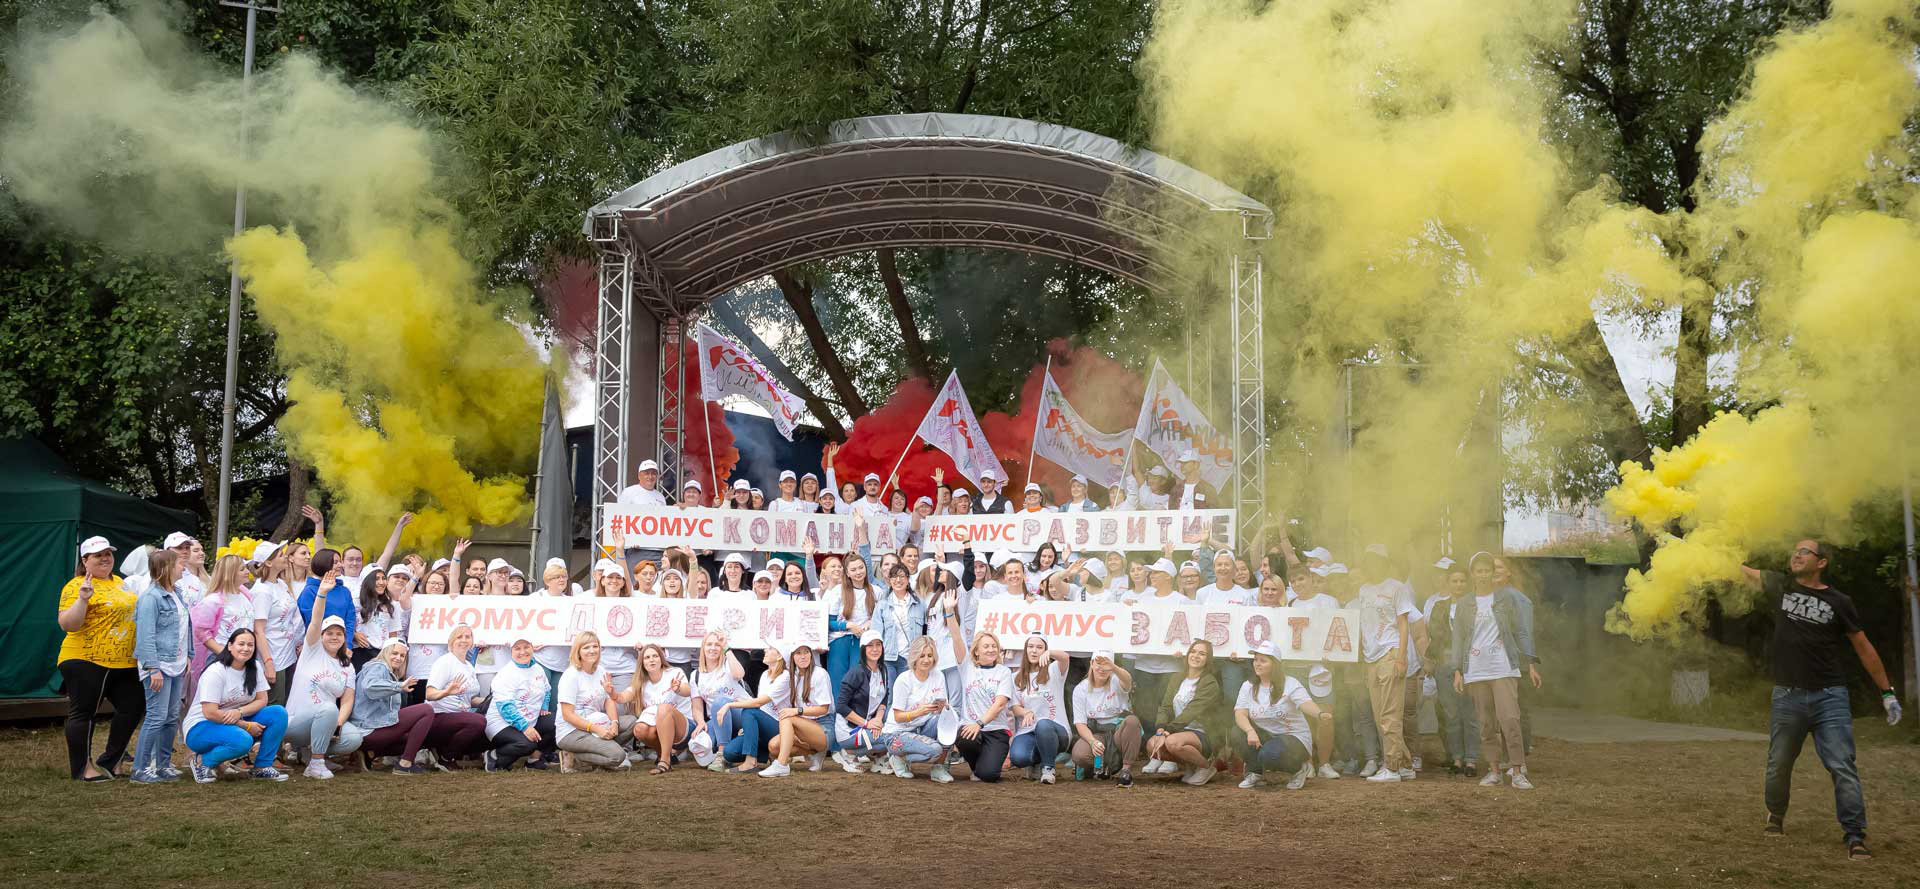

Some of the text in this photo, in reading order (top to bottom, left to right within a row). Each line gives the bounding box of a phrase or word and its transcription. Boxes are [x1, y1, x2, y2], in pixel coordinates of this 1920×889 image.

[610, 514, 713, 537] #КОМУС
[1782, 599, 1834, 624] WARS
[1783, 592, 1832, 611] STAR
[418, 603, 822, 642] #КОМУС ДОВЕРИЕ
[983, 612, 1116, 638] #КОМУС
[1130, 610, 1352, 652] ЗАБОТА
